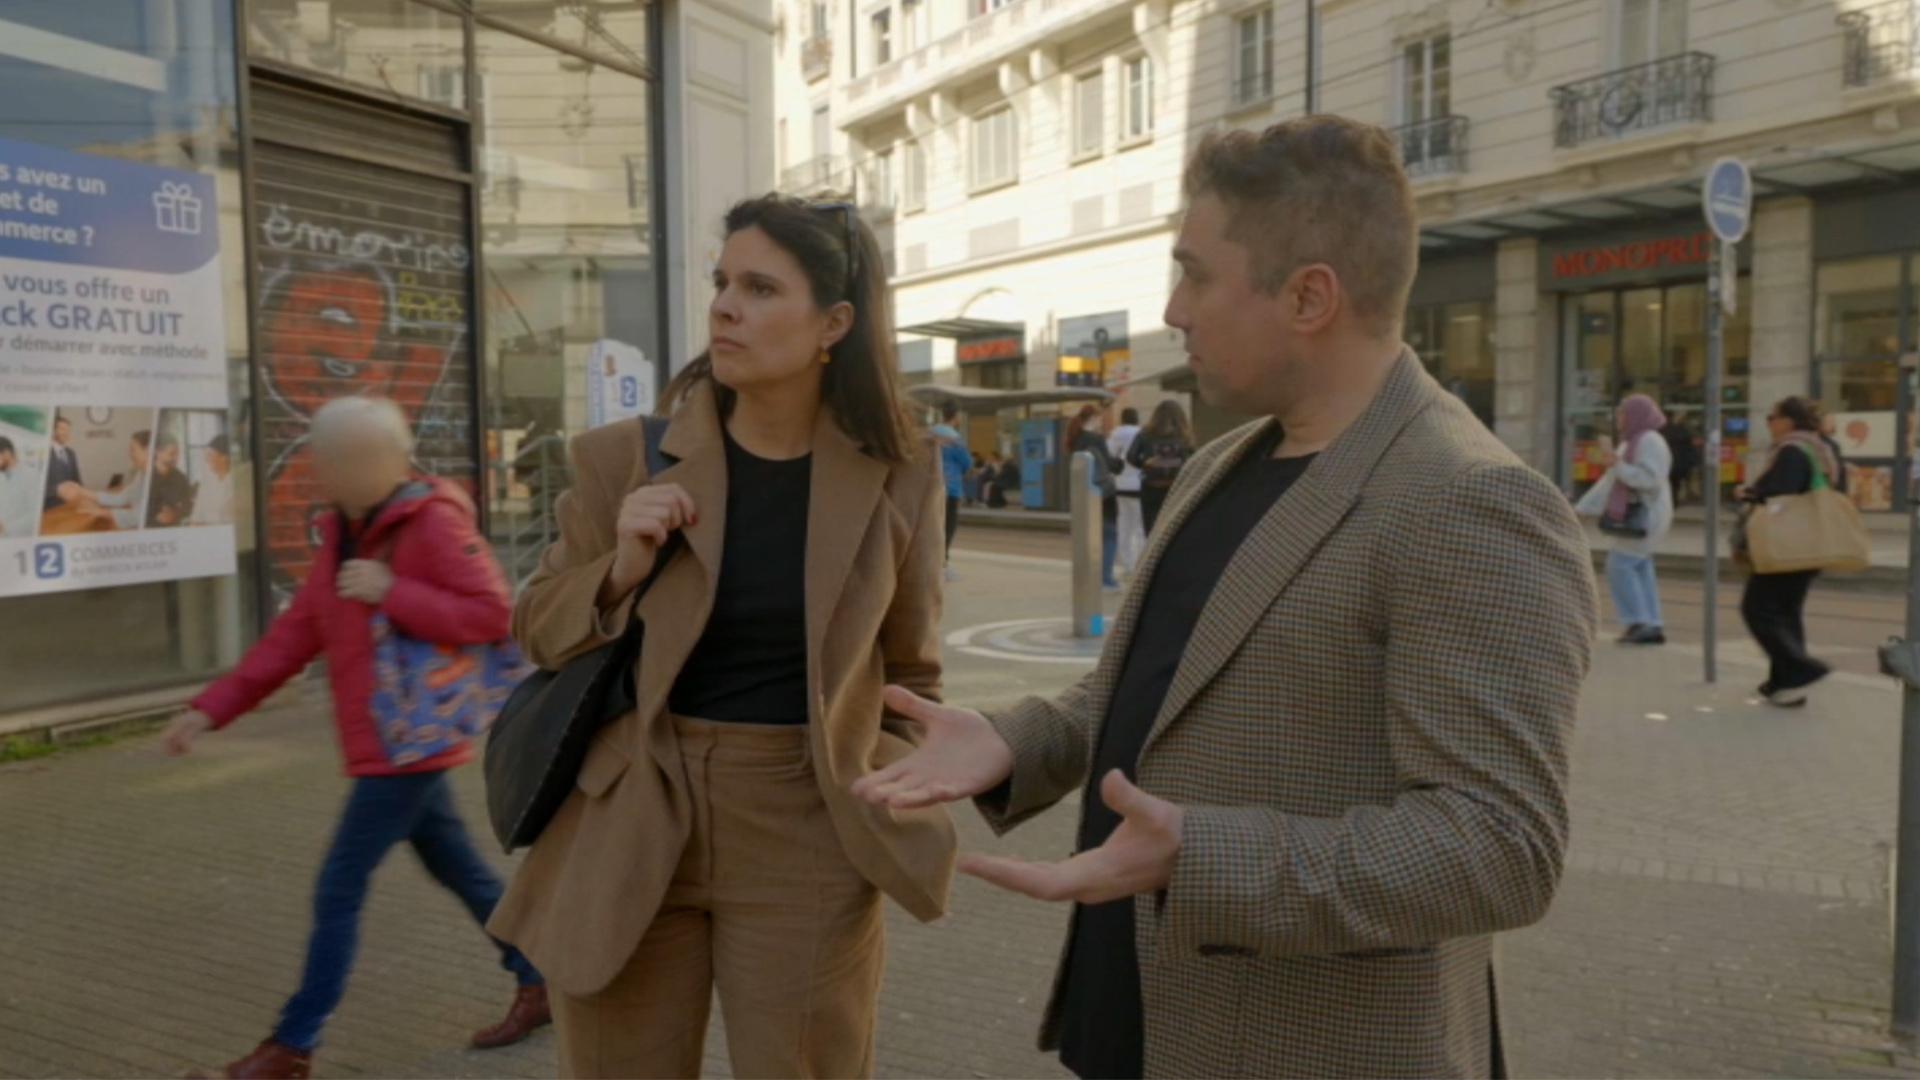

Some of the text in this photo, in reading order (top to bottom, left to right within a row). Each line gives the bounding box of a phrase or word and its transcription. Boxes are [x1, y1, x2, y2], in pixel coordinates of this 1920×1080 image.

[16, 166, 71, 191] avez
[78, 177, 106, 195] un
[28, 192, 58, 215] de
[3, 275, 169, 304] vous offre un
[48, 303, 183, 336] GRATUIT
[100, 343, 139, 357] avec
[71, 541, 178, 563] COMMERCES
